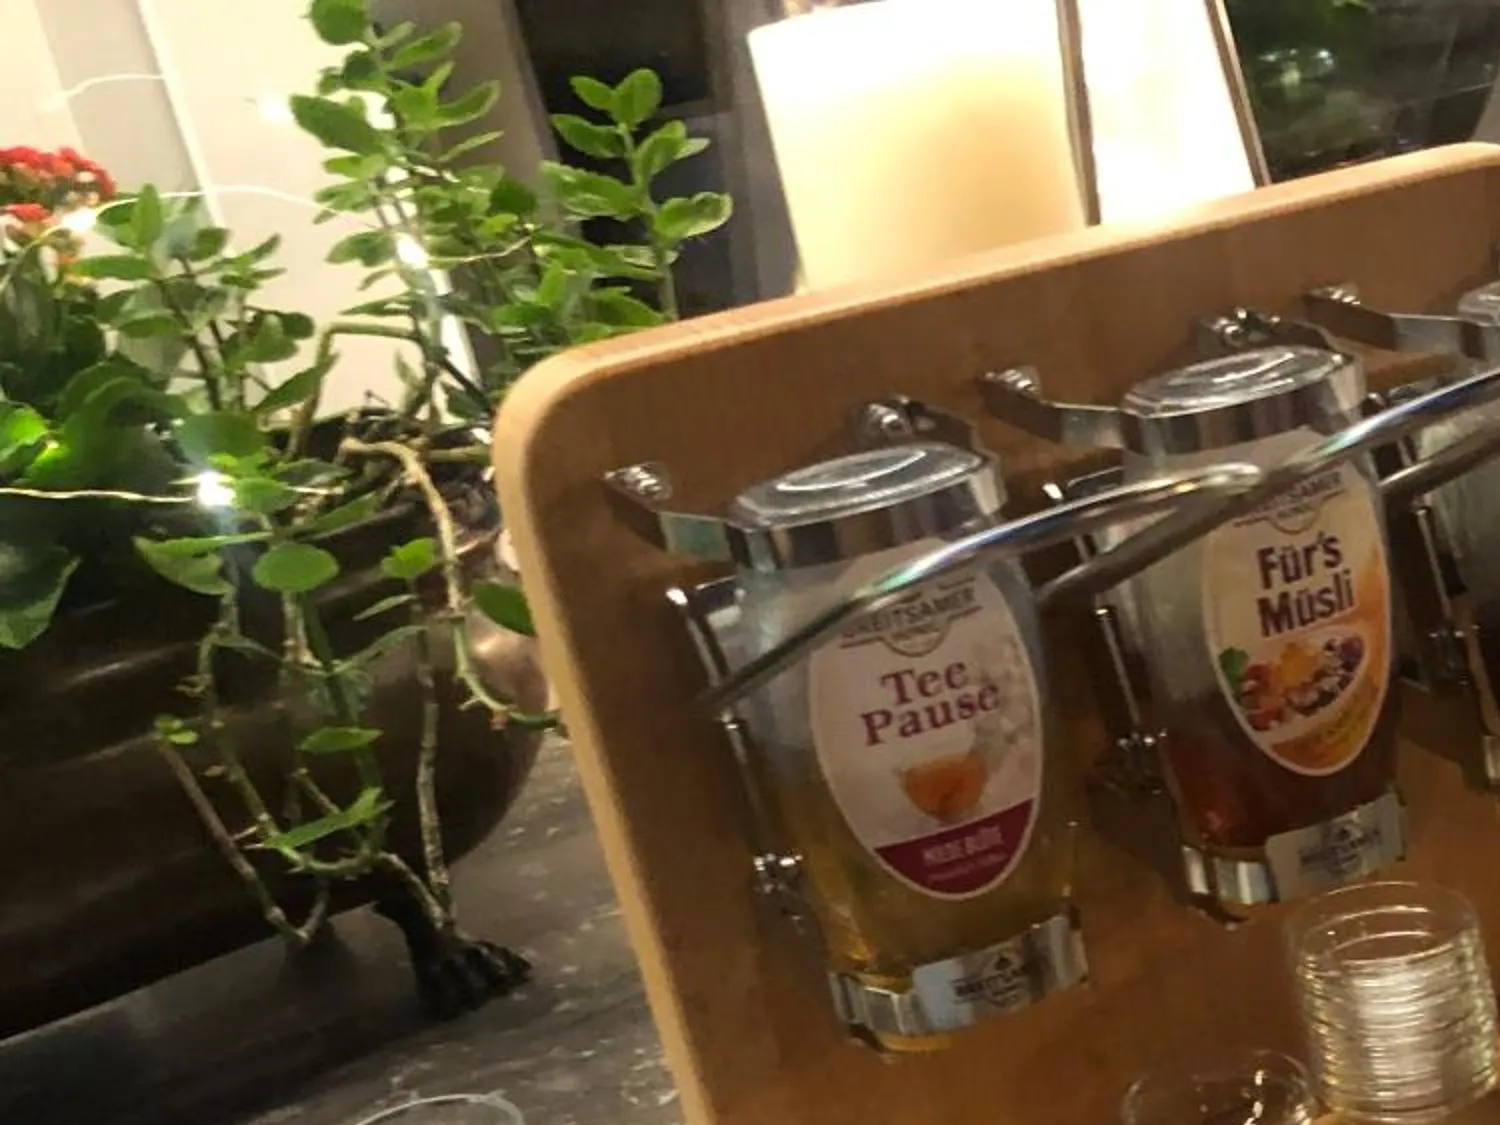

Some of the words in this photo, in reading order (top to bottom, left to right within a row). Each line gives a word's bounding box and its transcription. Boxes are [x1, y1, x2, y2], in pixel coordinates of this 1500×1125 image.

[1257, 531, 1342, 590] Für's
[1257, 569, 1354, 637] Müsli
[880, 661, 968, 706] Tee
[860, 684, 1000, 747] Pause
